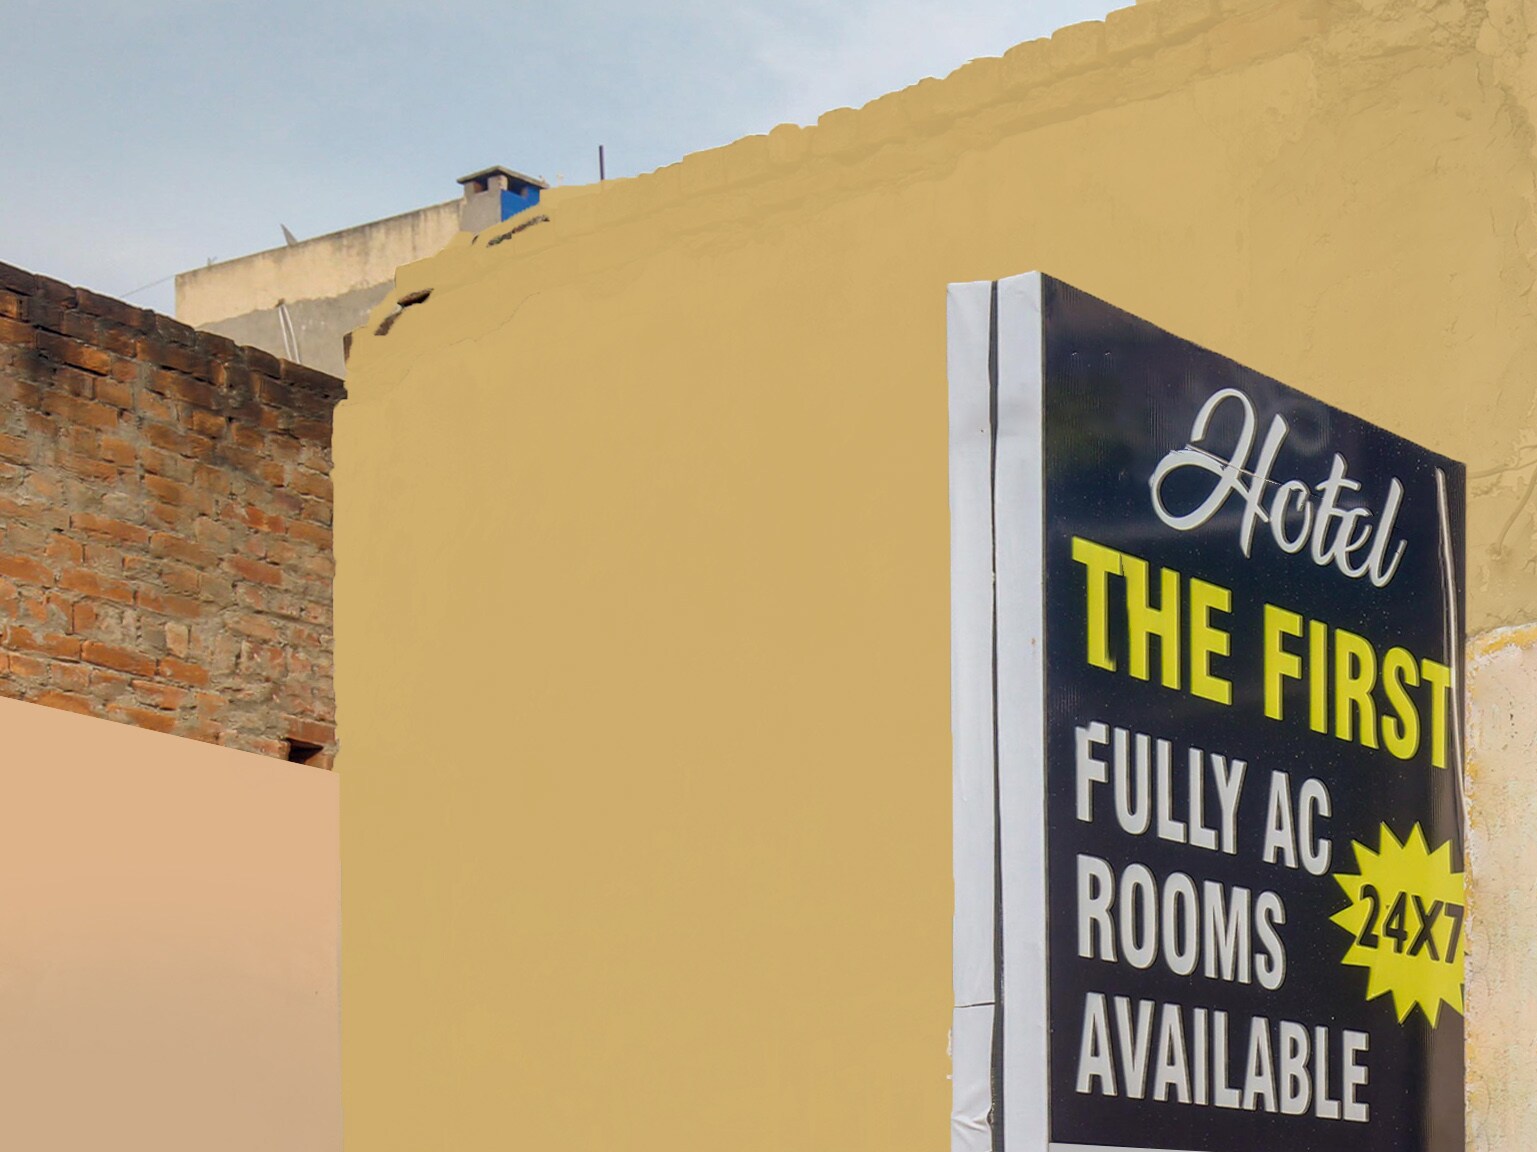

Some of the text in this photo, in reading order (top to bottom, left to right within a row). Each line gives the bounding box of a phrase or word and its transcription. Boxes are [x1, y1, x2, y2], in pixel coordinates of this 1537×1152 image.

[1150, 387, 1408, 588] Hotel
[1071, 536, 1453, 769] THE FIRST
[1075, 721, 1333, 876] FULLY AC
[1076, 853, 1287, 990] ROOMS
[1356, 884, 1464, 964] 24X7
[1076, 992, 1370, 1123] AVAILABLE
